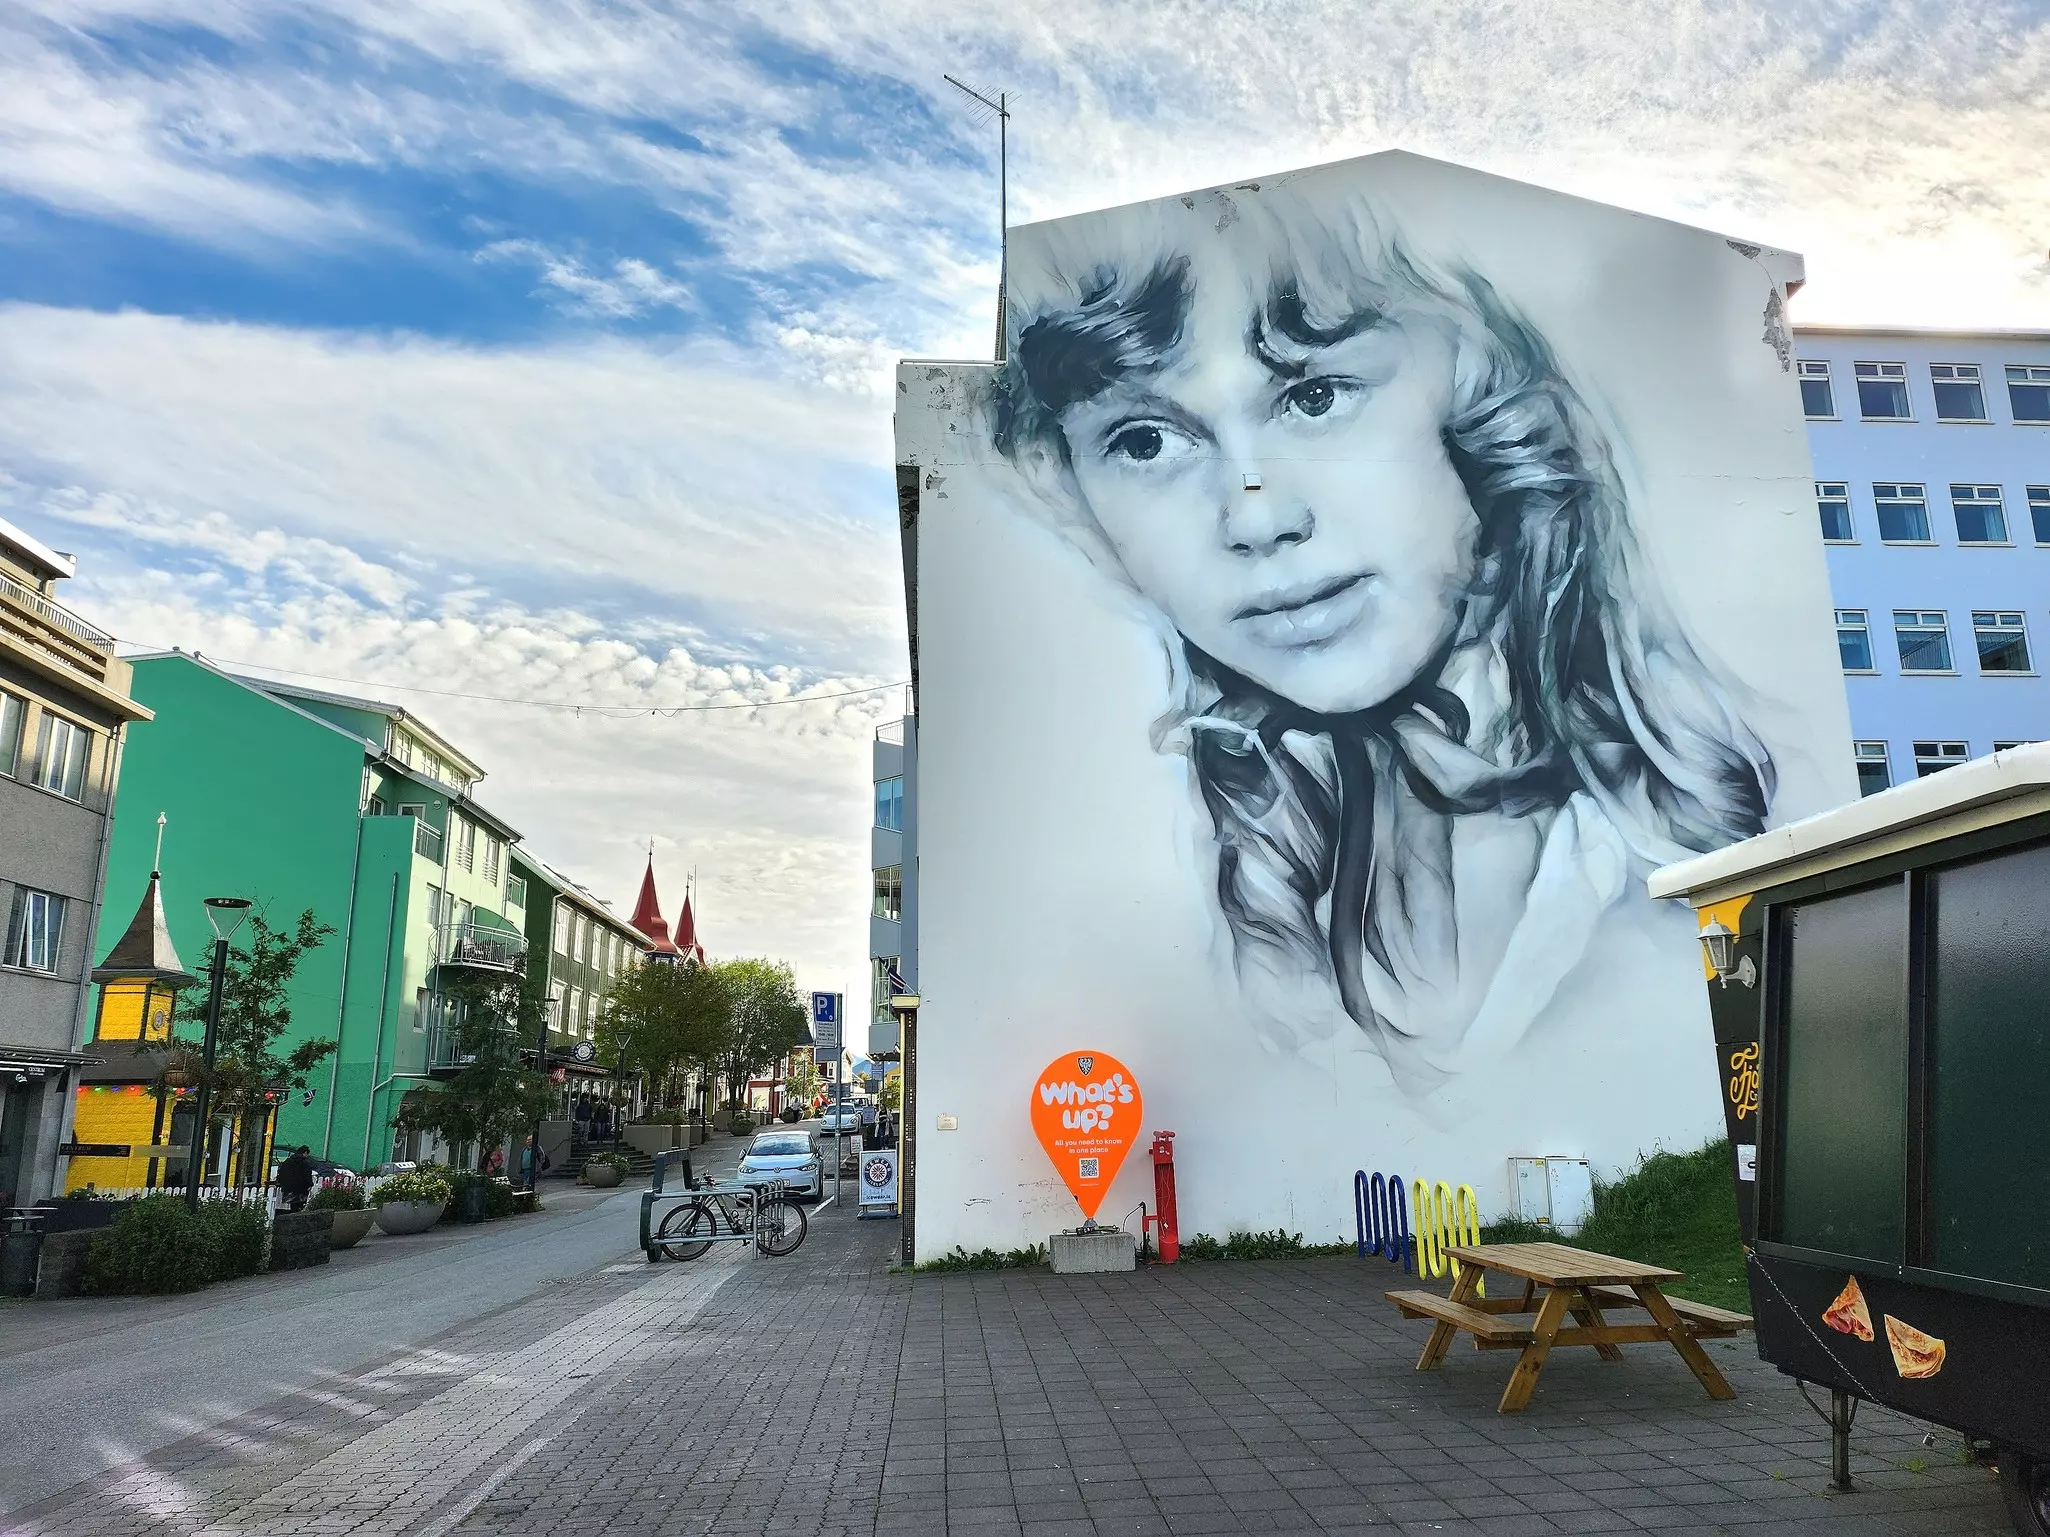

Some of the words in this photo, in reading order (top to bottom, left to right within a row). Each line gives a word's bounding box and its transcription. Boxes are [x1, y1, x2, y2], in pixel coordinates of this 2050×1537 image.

[816, 996, 828, 1014] P
[1062, 1104, 1114, 1134] up?
[1089, 1146, 1109, 1154] place
[864, 1158, 892, 1174] ICEWEAR
